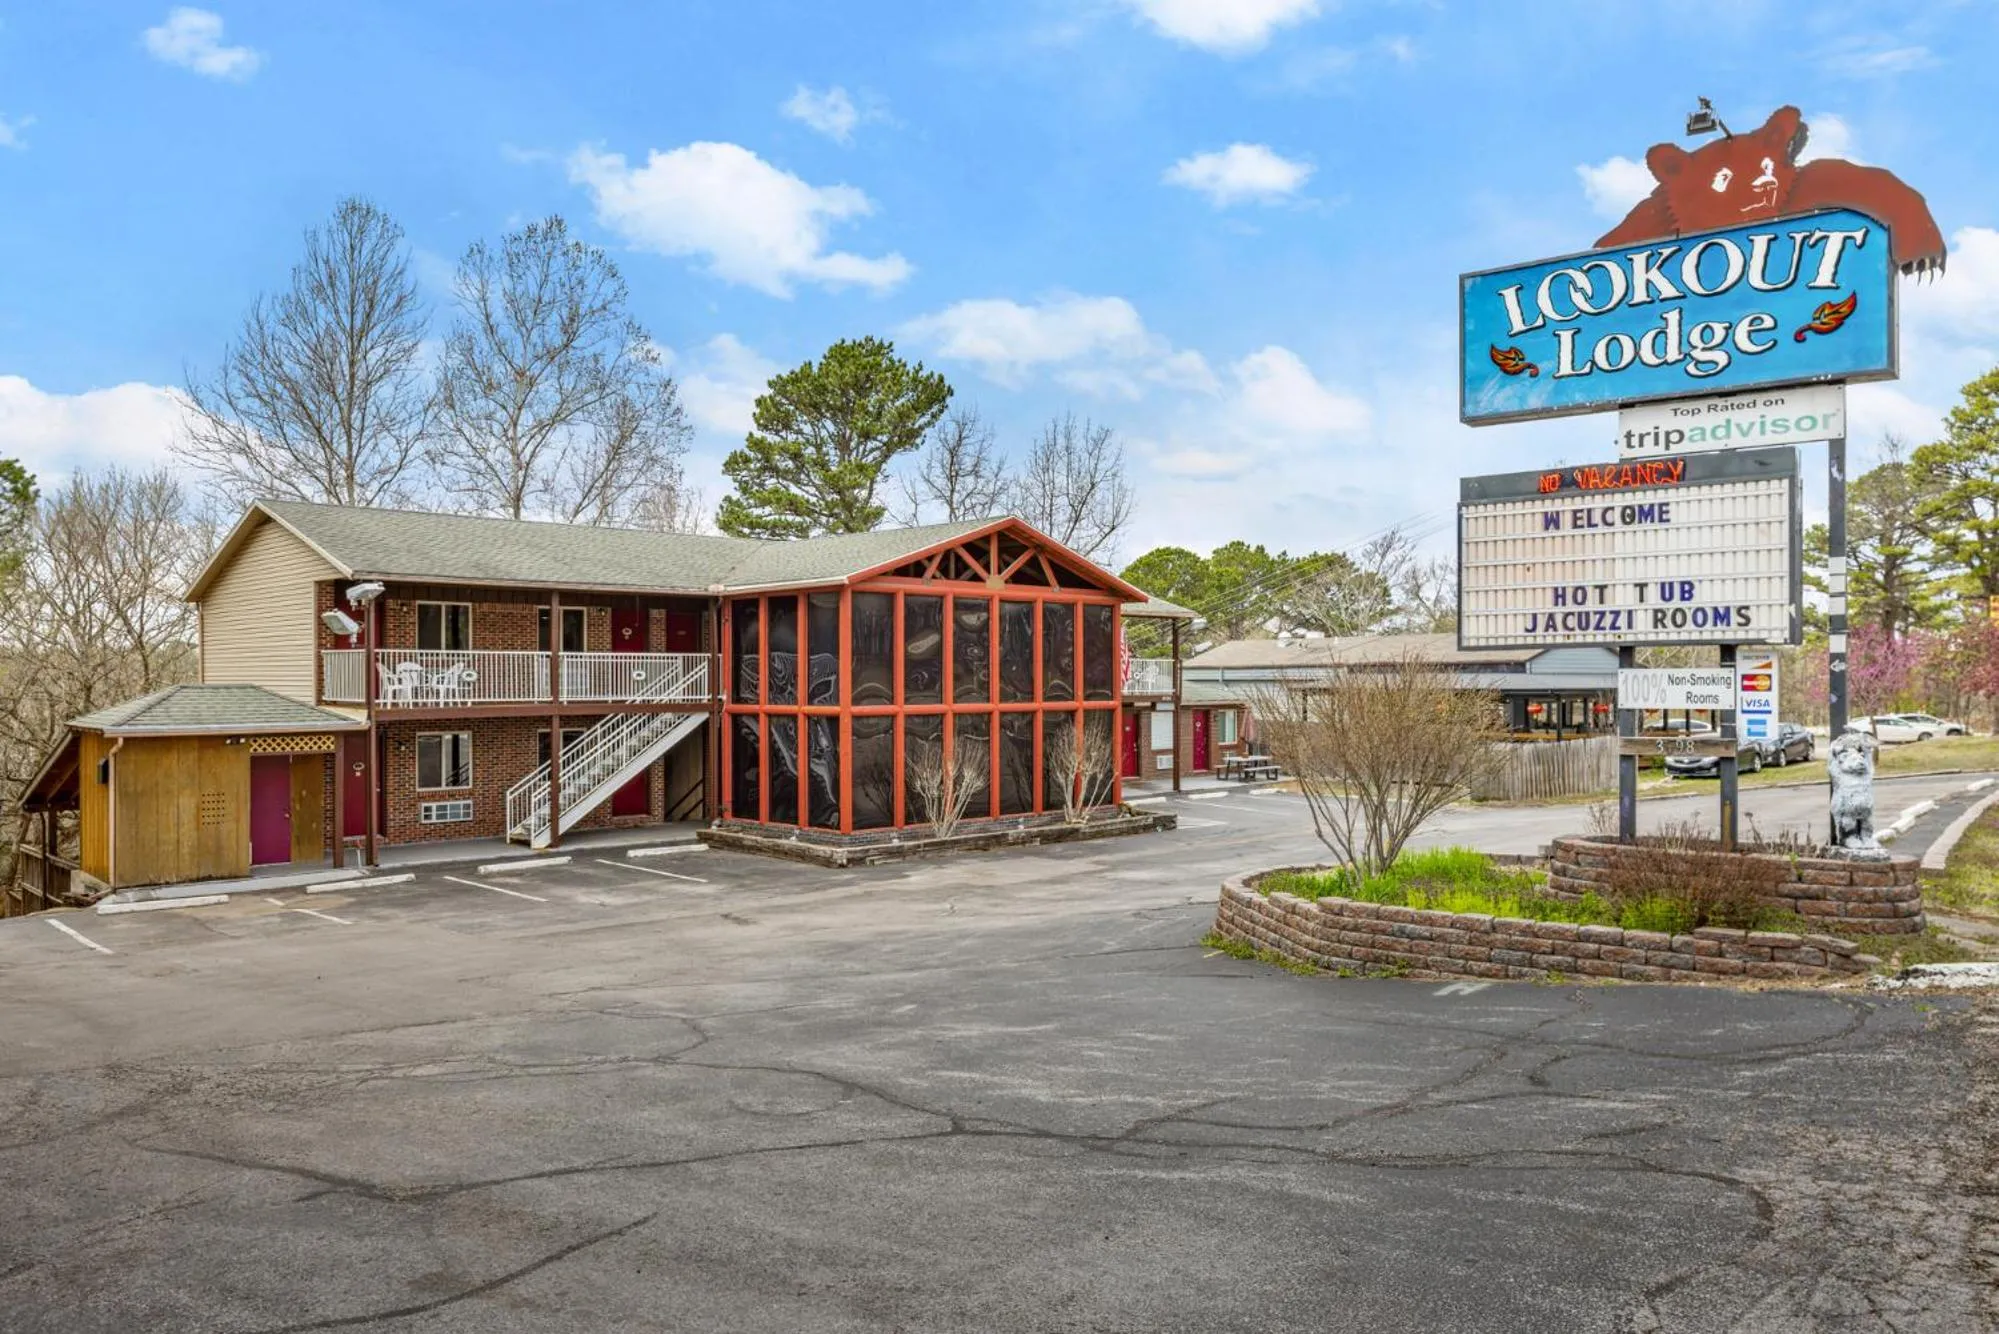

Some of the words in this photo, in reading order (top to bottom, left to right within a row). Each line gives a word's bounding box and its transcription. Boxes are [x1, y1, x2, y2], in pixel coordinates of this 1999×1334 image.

[1498, 227, 1868, 337] LOOKOUT
[1553, 307, 1777, 379] Lodge
[1670, 407, 1702, 417] Top
[1707, 399, 1757, 413] Rated
[1763, 397, 1786, 406] on
[1623, 411, 1838, 451] tripadvisor
[1539, 472, 1562, 493] NO
[1574, 456, 1684, 490] VACANCY
[1543, 502, 1671, 531] WELCOME
[1553, 584, 1609, 607] HOT
[1634, 579, 1695, 603] TUB
[1524, 608, 1634, 633] JACUZZI
[1653, 604, 1752, 630] ROOMS
[1622, 673, 1667, 704] 100%
[1667, 673, 1732, 689] Non-Smoking
[1686, 691, 1720, 704] Rooms
[1745, 699, 1771, 707] VISA
